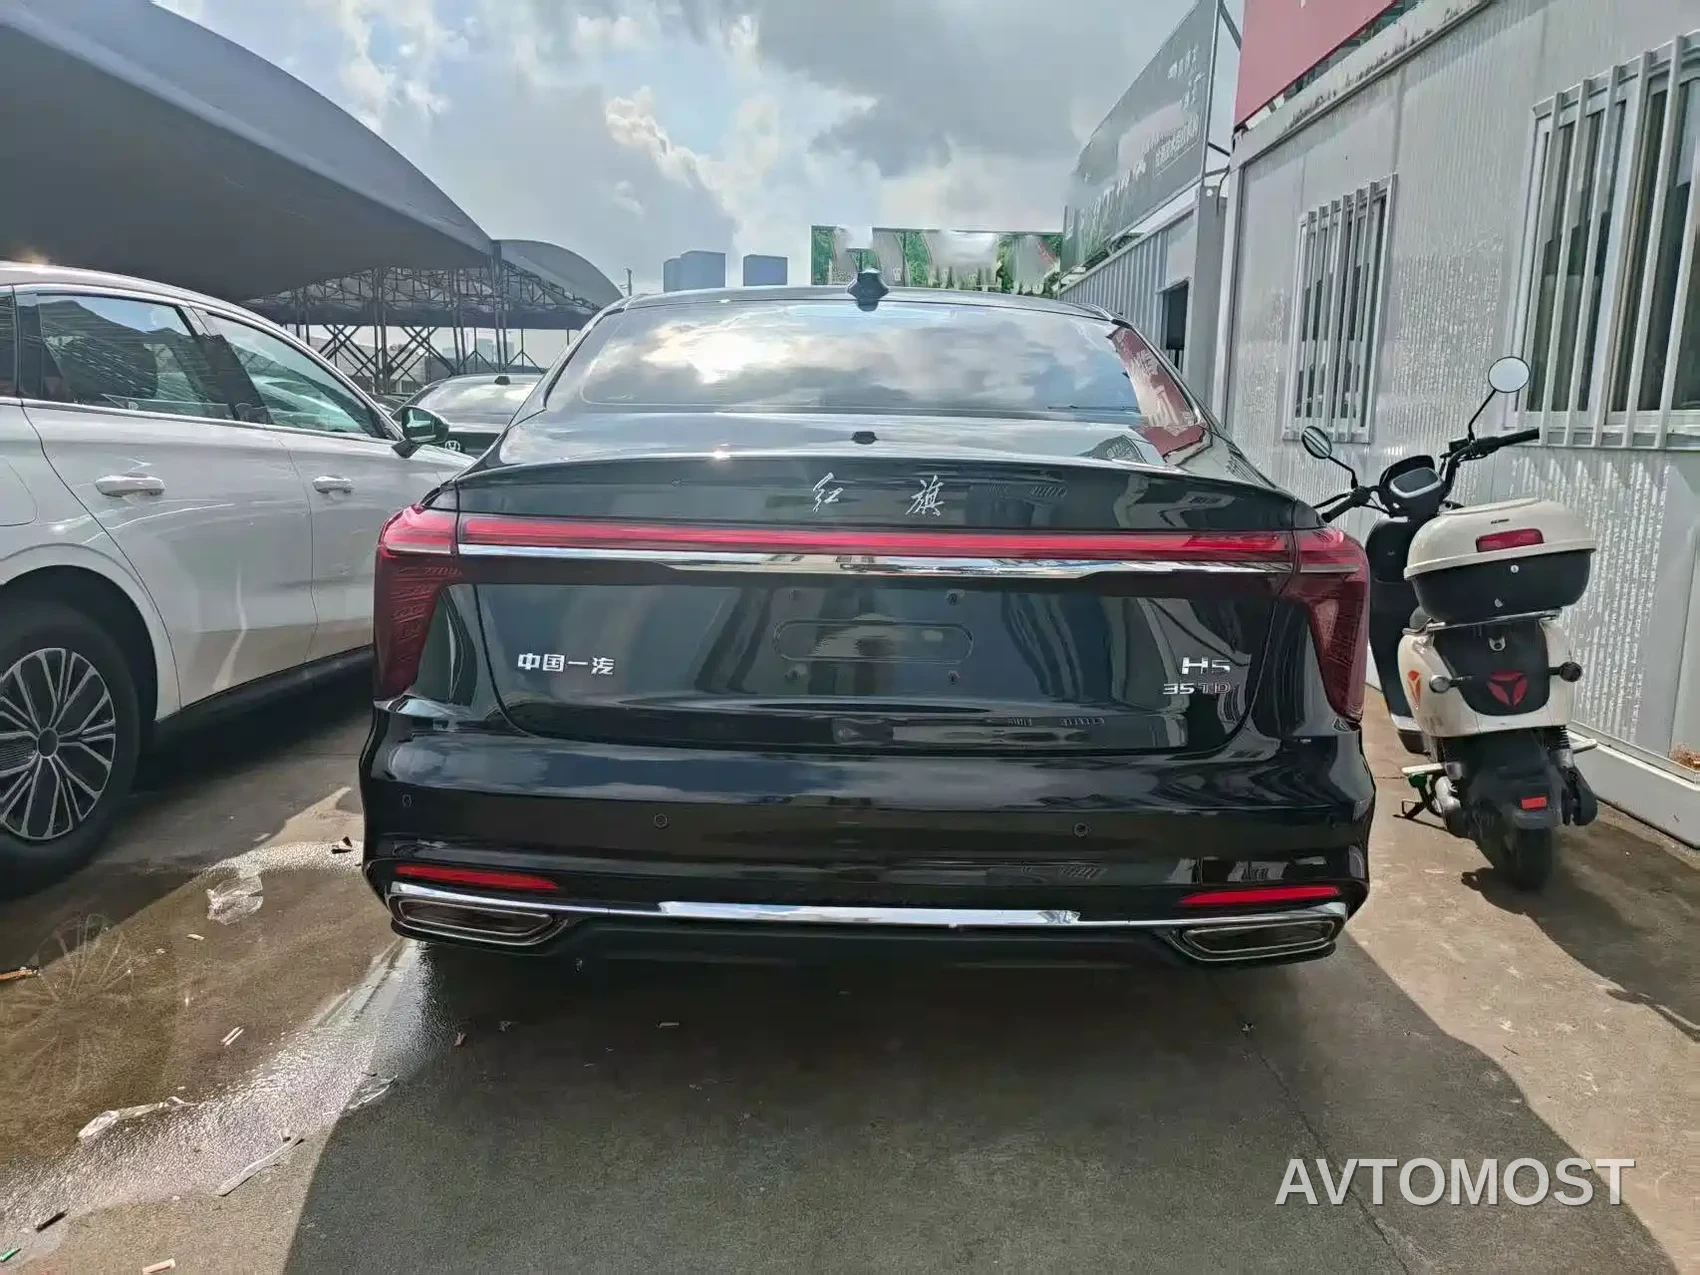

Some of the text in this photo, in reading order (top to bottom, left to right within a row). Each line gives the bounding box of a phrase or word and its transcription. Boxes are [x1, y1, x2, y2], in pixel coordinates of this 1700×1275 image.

[812, 472, 945, 516] 红旗
[517, 652, 615, 675] 中国一汽
